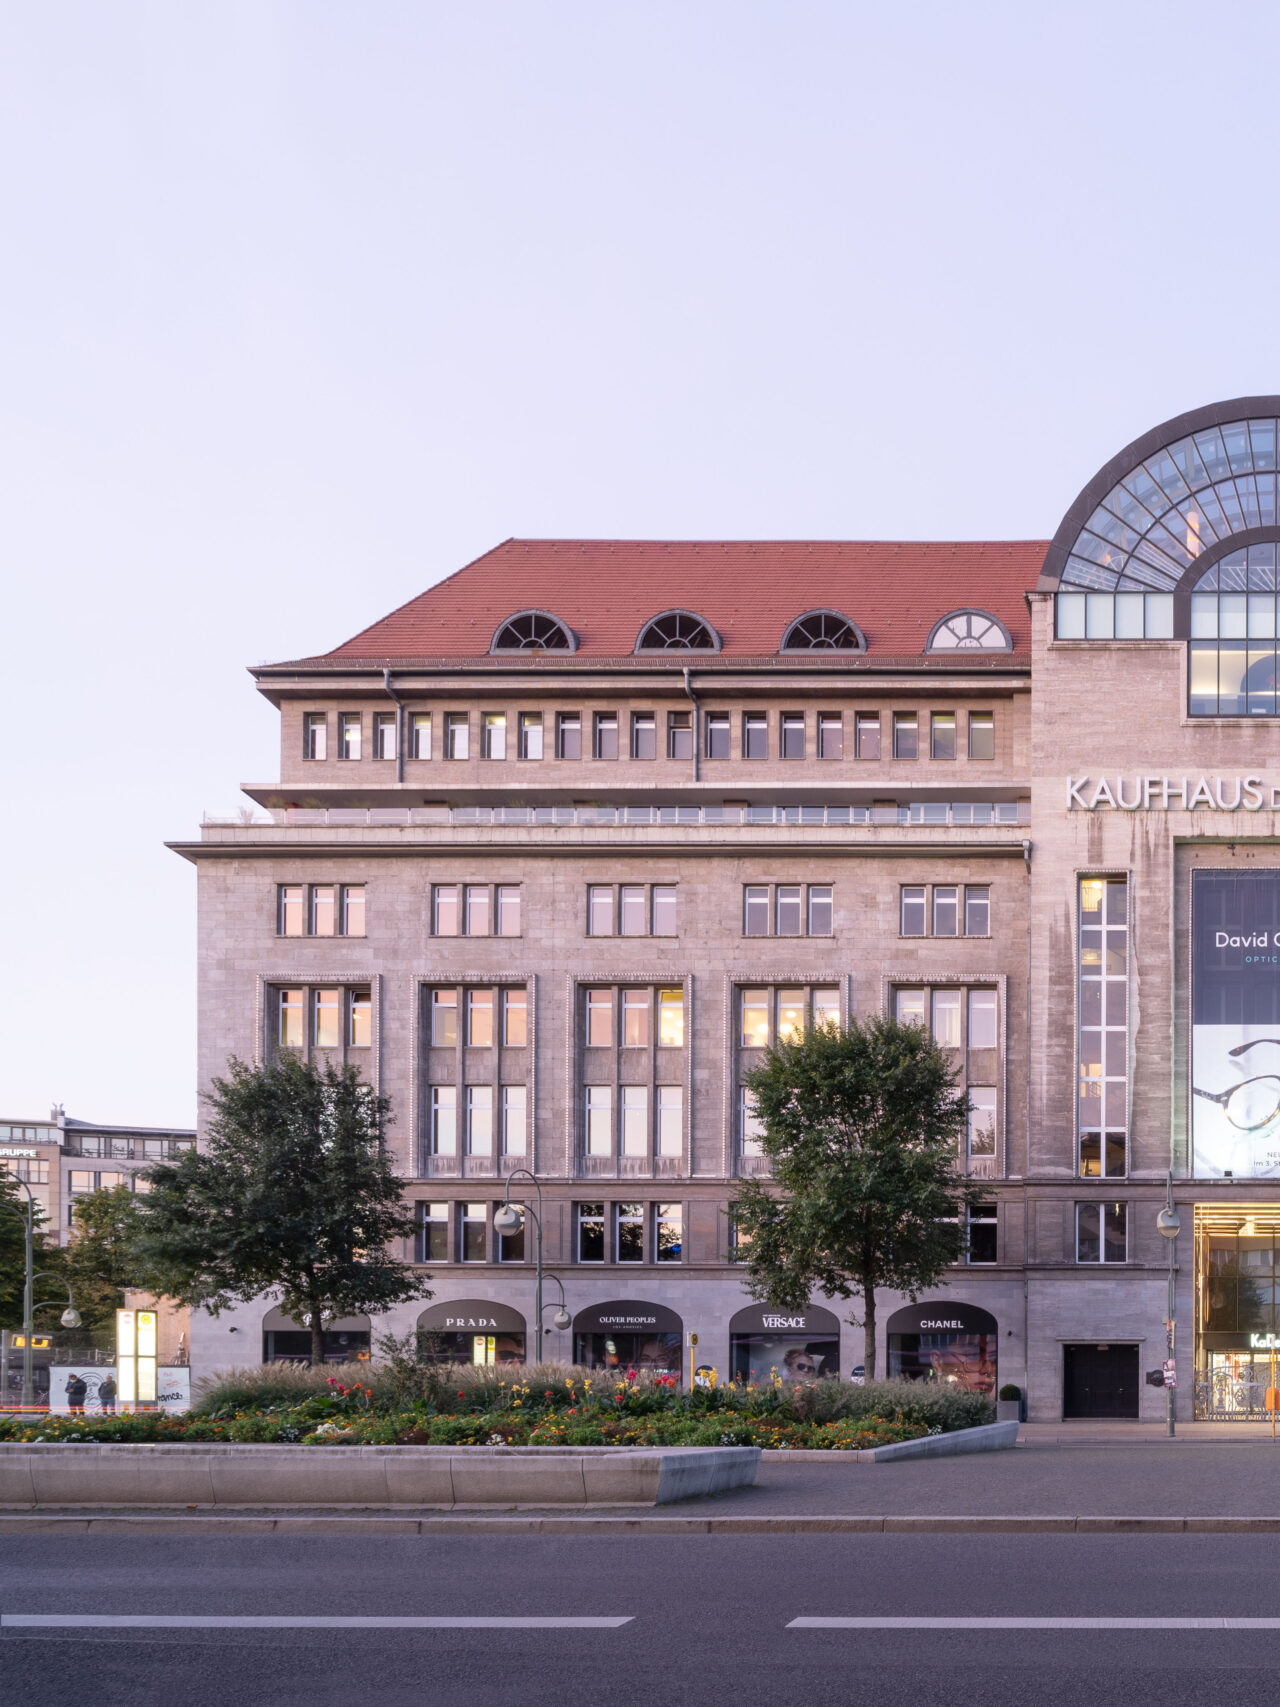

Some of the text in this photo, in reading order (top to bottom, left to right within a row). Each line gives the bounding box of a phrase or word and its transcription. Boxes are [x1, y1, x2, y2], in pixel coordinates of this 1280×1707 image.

[1066, 775, 1262, 810] KAUFHAUS
[1215, 931, 1268, 947] David
[445, 1318, 498, 1327] PRADA
[599, 1316, 656, 1324] OLIVER PEOPLES
[762, 1317, 806, 1328] VERSACE
[920, 1320, 964, 1328] CHANEL
